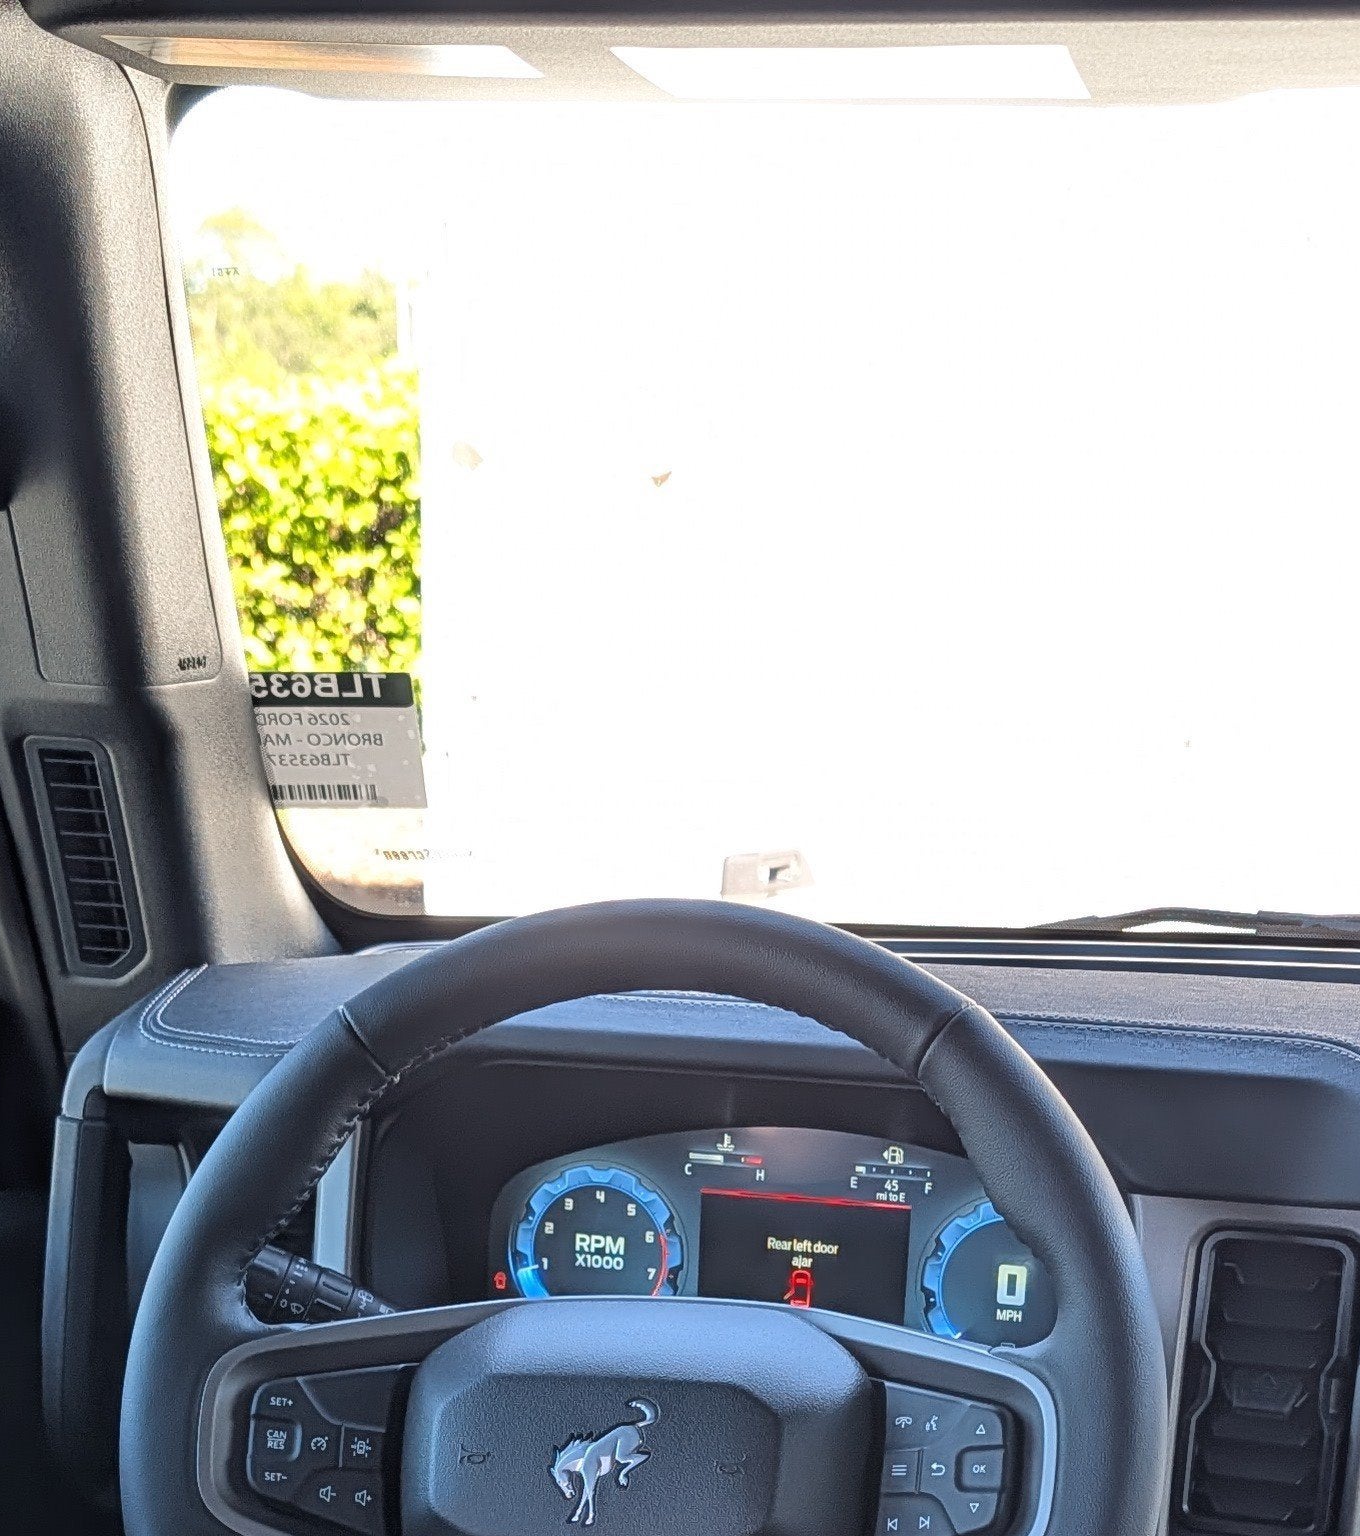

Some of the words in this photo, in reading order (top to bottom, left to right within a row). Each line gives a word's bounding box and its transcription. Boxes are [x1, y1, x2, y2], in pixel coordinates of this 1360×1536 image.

[684, 1163, 692, 1176] C
[755, 1169, 765, 1182] H
[850, 1176, 859, 1189] E
[884, 1180, 899, 1192] 45
[924, 1182, 933, 1195] F
[595, 1190, 605, 1203] 4
[564, 1198, 574, 1211] 3
[627, 1203, 637, 1217] 5
[544, 1222, 554, 1234] 2
[645, 1231, 655, 1243] 6
[574, 1232, 626, 1256] RPM
[767, 1236, 792, 1252] Rear
[793, 1238, 813, 1253] left
[813, 1242, 839, 1255] door
[574, 1253, 624, 1271] X1000
[791, 1255, 813, 1269] ajar
[647, 1267, 657, 1280] 7
[996, 1264, 1027, 1307] 0
[996, 1308, 1022, 1323] MPH
[269, 1396, 294, 1407] SET+
[266, 1429, 287, 1439] CAN
[972, 1464, 987, 1474] OK
